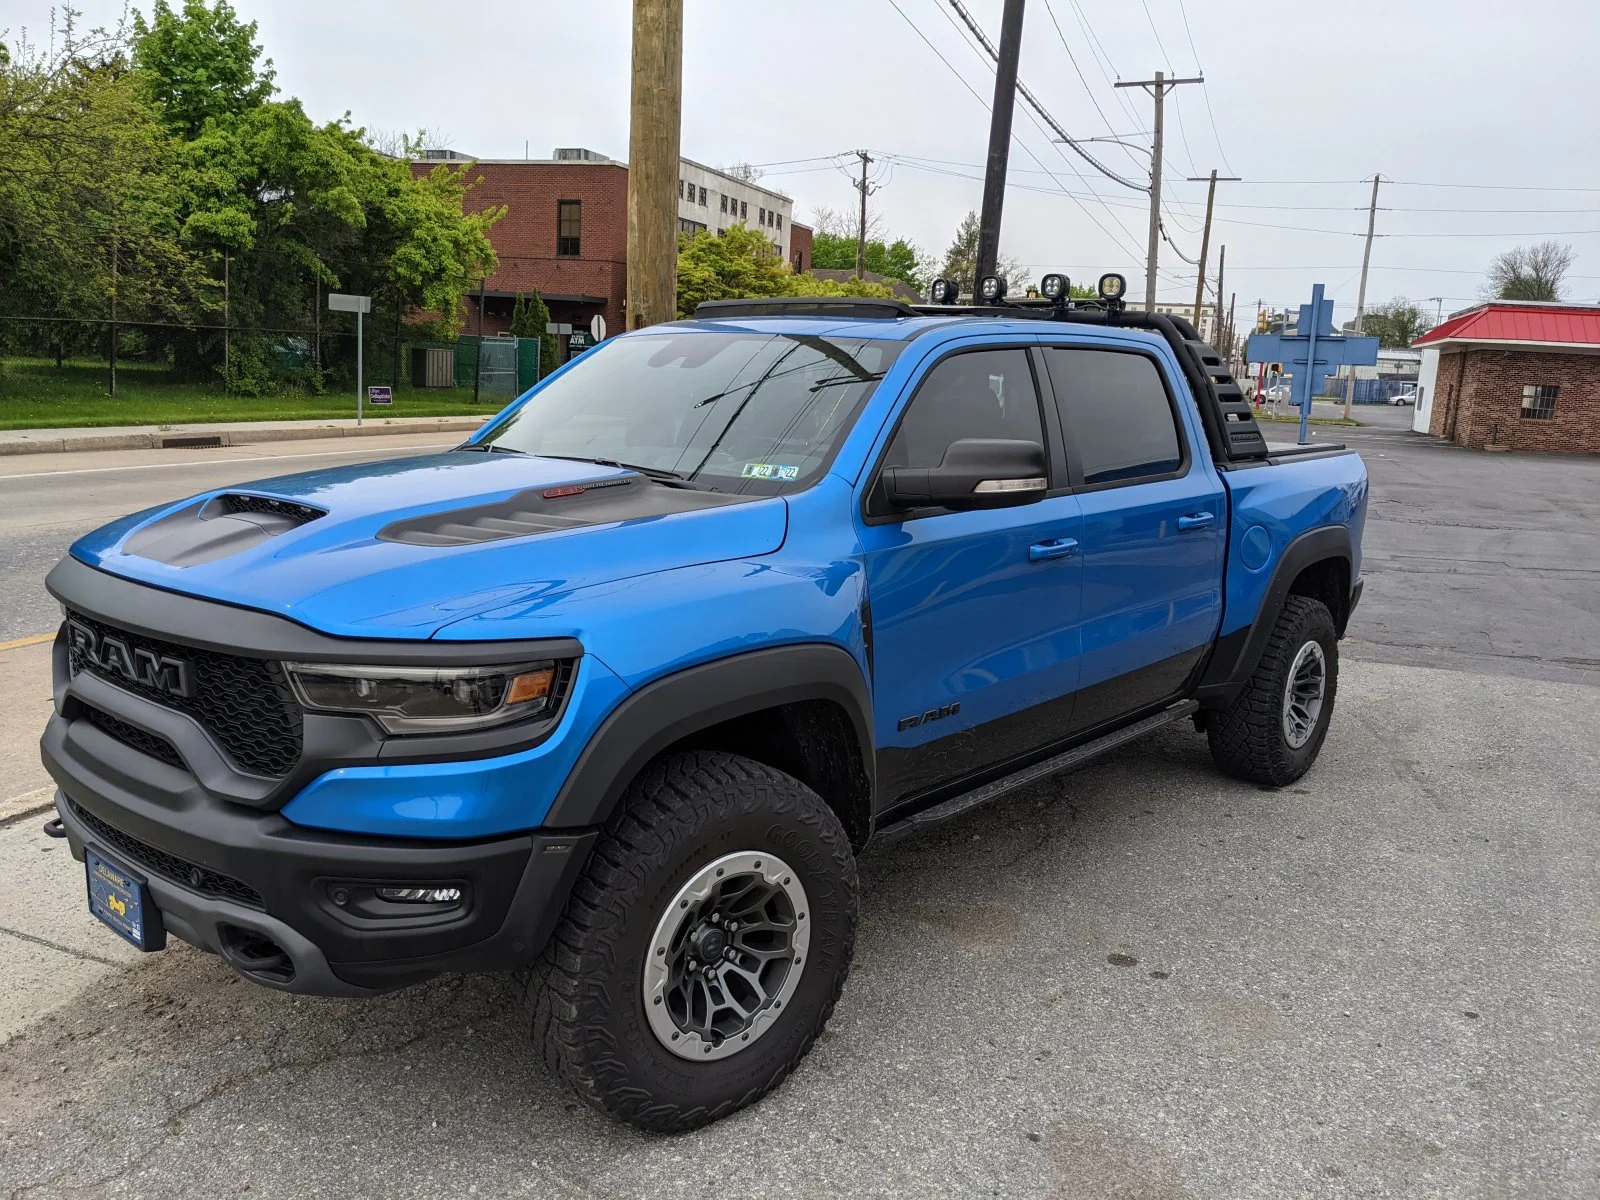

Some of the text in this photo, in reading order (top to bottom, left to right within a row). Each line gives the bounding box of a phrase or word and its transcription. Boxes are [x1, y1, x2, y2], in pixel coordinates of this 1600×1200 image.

[759, 466, 769, 476] 22
[786, 468, 796, 478] 22
[69, 618, 189, 697] RAM
[897, 701, 961, 732] RAM
[98, 864, 125, 888] DELAWARE
[767, 824, 839, 972] GOODYEAR
